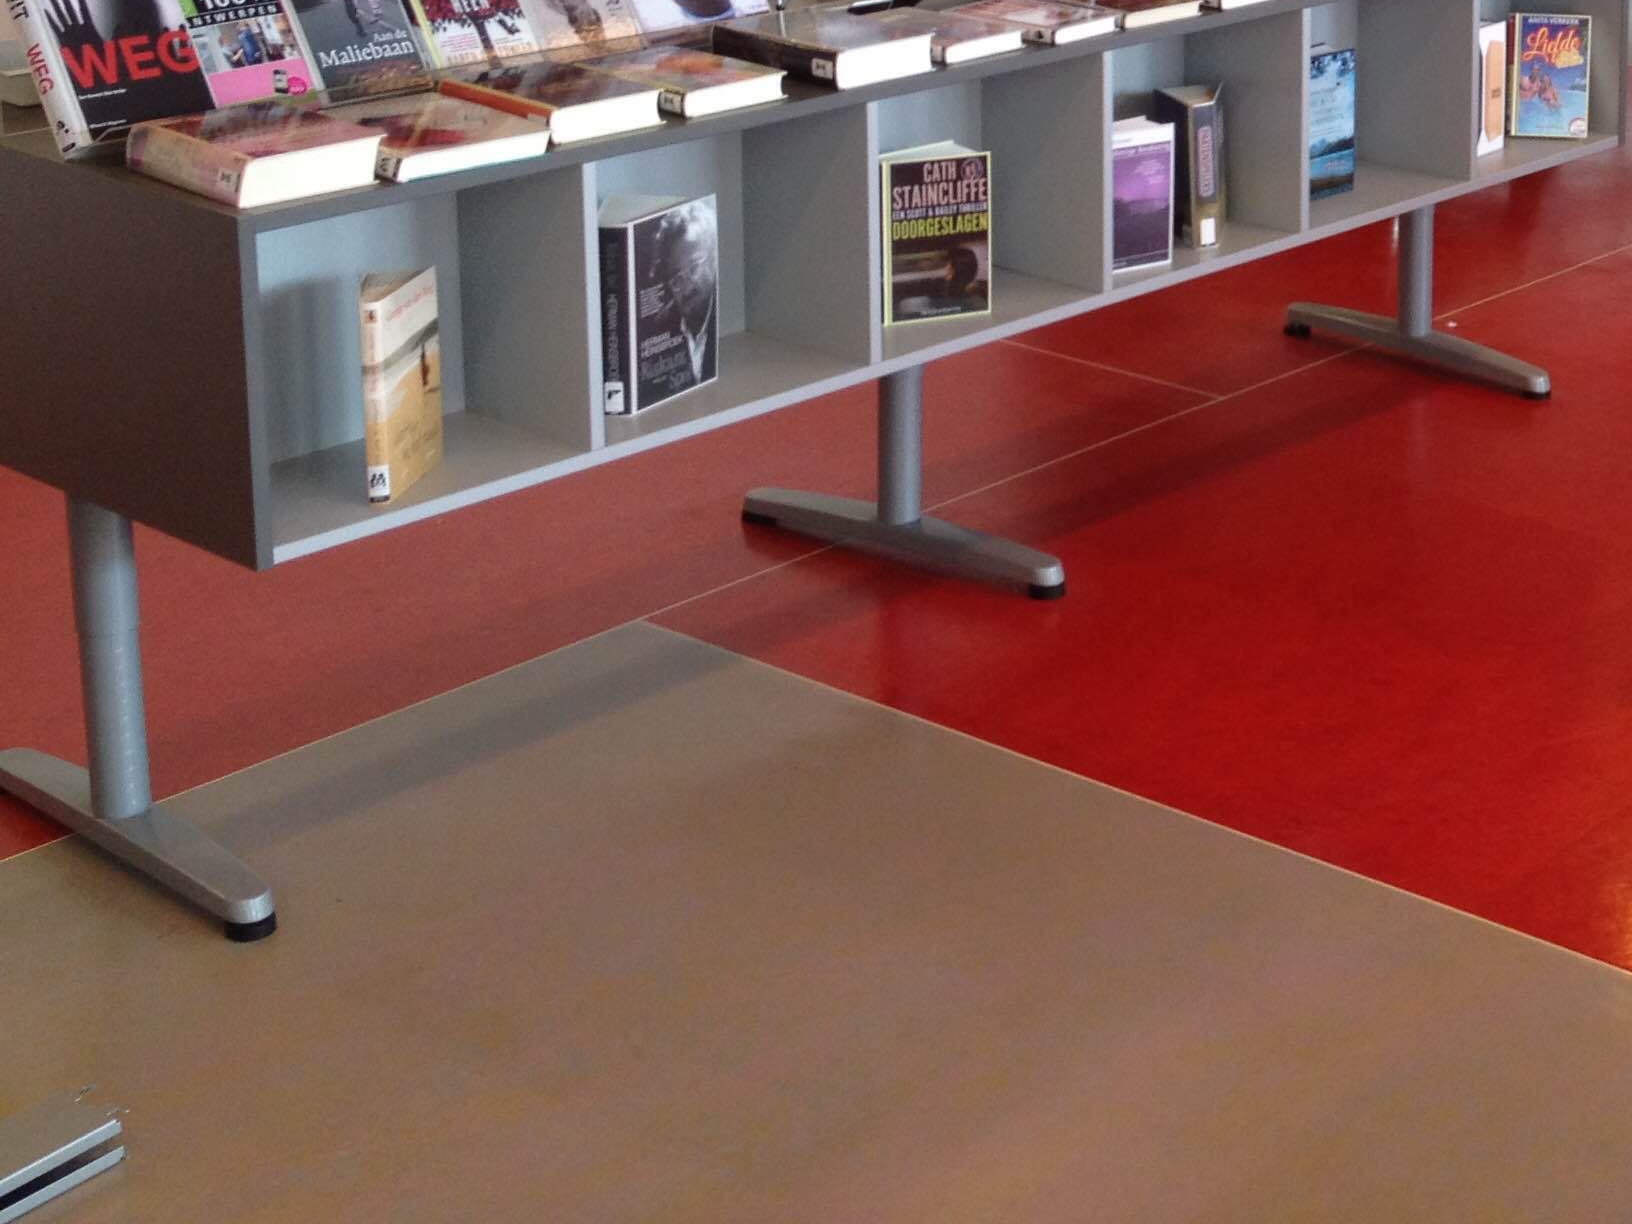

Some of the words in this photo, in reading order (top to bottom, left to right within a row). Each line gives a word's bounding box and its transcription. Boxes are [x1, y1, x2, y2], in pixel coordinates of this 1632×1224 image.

[373, 31, 393, 43] Aan
[394, 27, 408, 39] de
[27, 42, 54, 96] WEG
[59, 29, 200, 90] WEG
[318, 39, 415, 69] Maliebaan
[923, 159, 958, 183] CATH
[892, 177, 988, 209] STAINCLIFFE
[892, 212, 989, 241] DOORGESLAGEN
